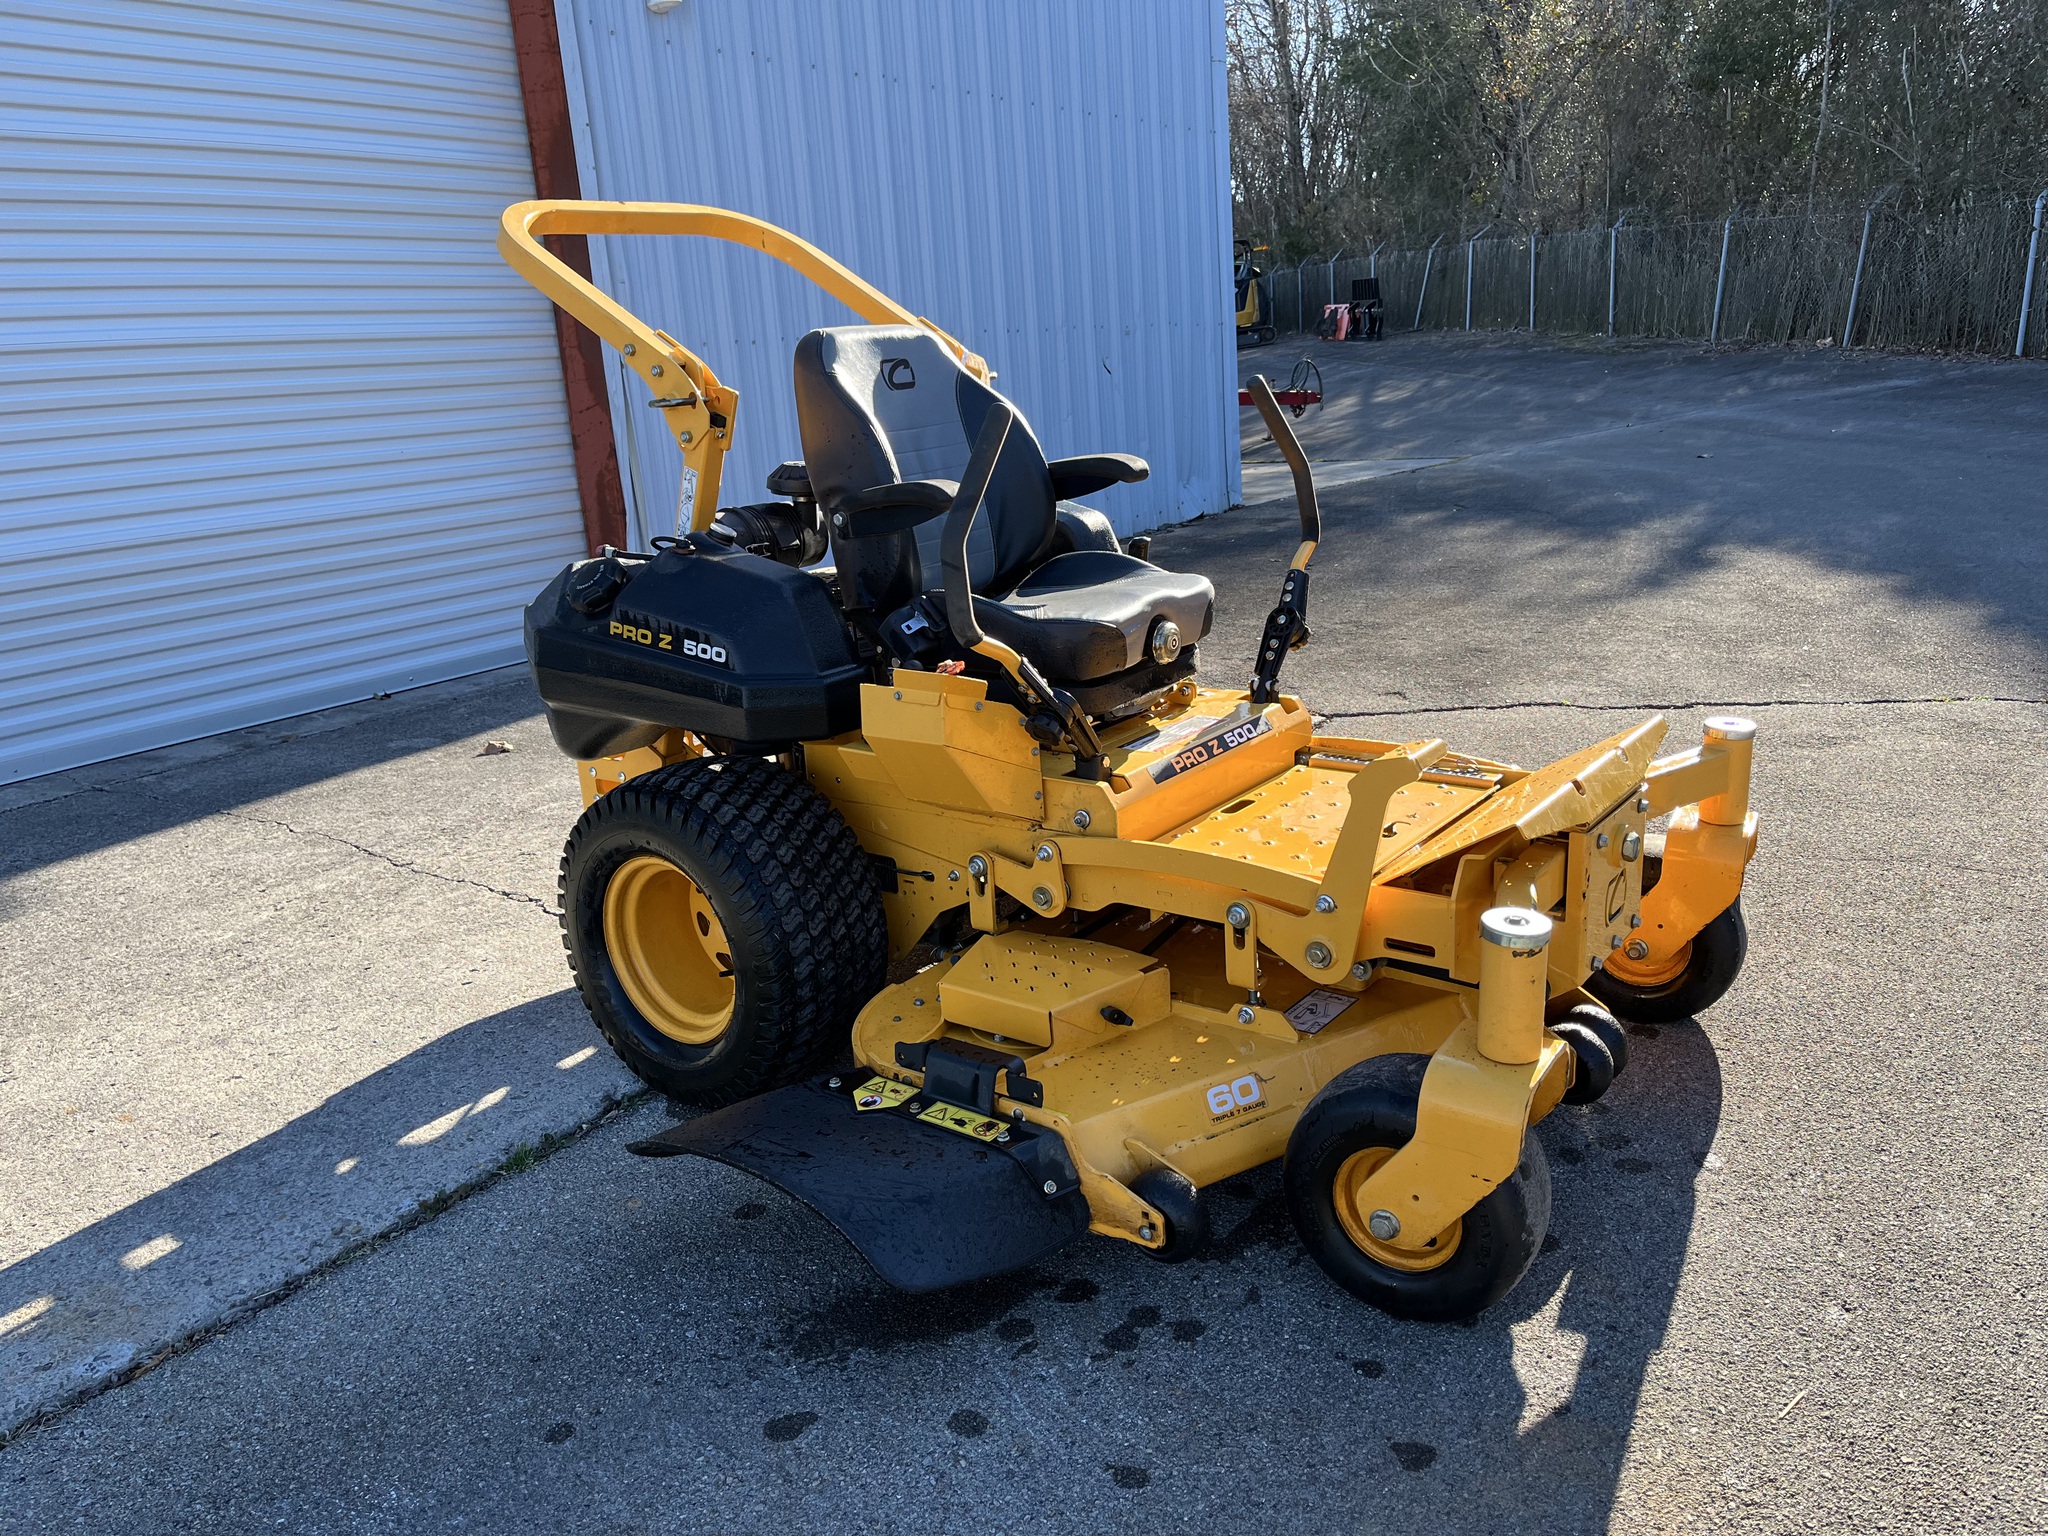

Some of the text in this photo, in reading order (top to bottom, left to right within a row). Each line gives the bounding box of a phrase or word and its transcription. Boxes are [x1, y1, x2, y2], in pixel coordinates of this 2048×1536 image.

[609, 620, 727, 663] PRO Z 500
[1170, 745, 1209, 773] PRO
[1207, 738, 1224, 756] Z
[1223, 723, 1258, 748] 500
[1206, 1075, 1260, 1115] 60
[1211, 1110, 1235, 1124] TRIPLE
[1242, 1100, 1267, 1113] GAUGE
